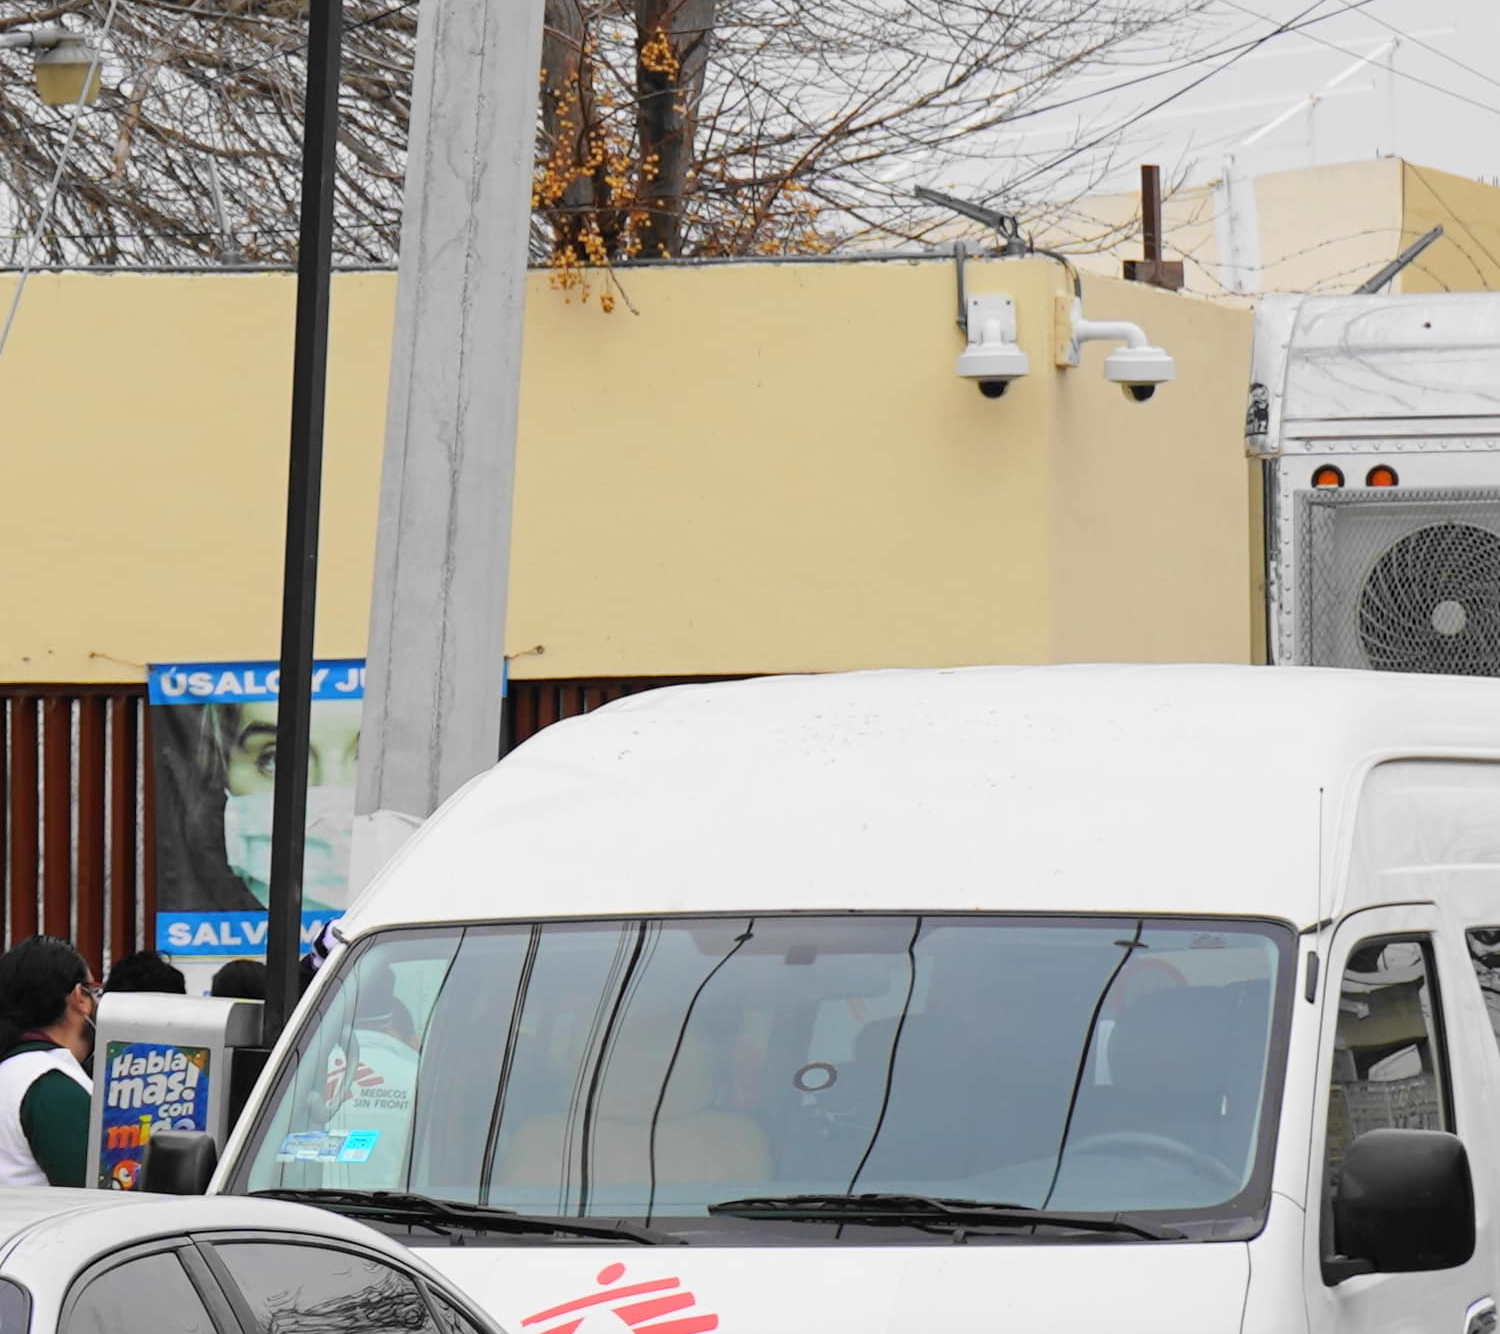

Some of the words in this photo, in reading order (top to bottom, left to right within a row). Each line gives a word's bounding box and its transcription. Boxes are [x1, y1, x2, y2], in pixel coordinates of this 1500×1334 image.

[112, 1049, 187, 1078] Habla
[360, 1088, 407, 1099] MEDICOS
[158, 1102, 194, 1118] con
[353, 1099, 371, 1108] SIN
